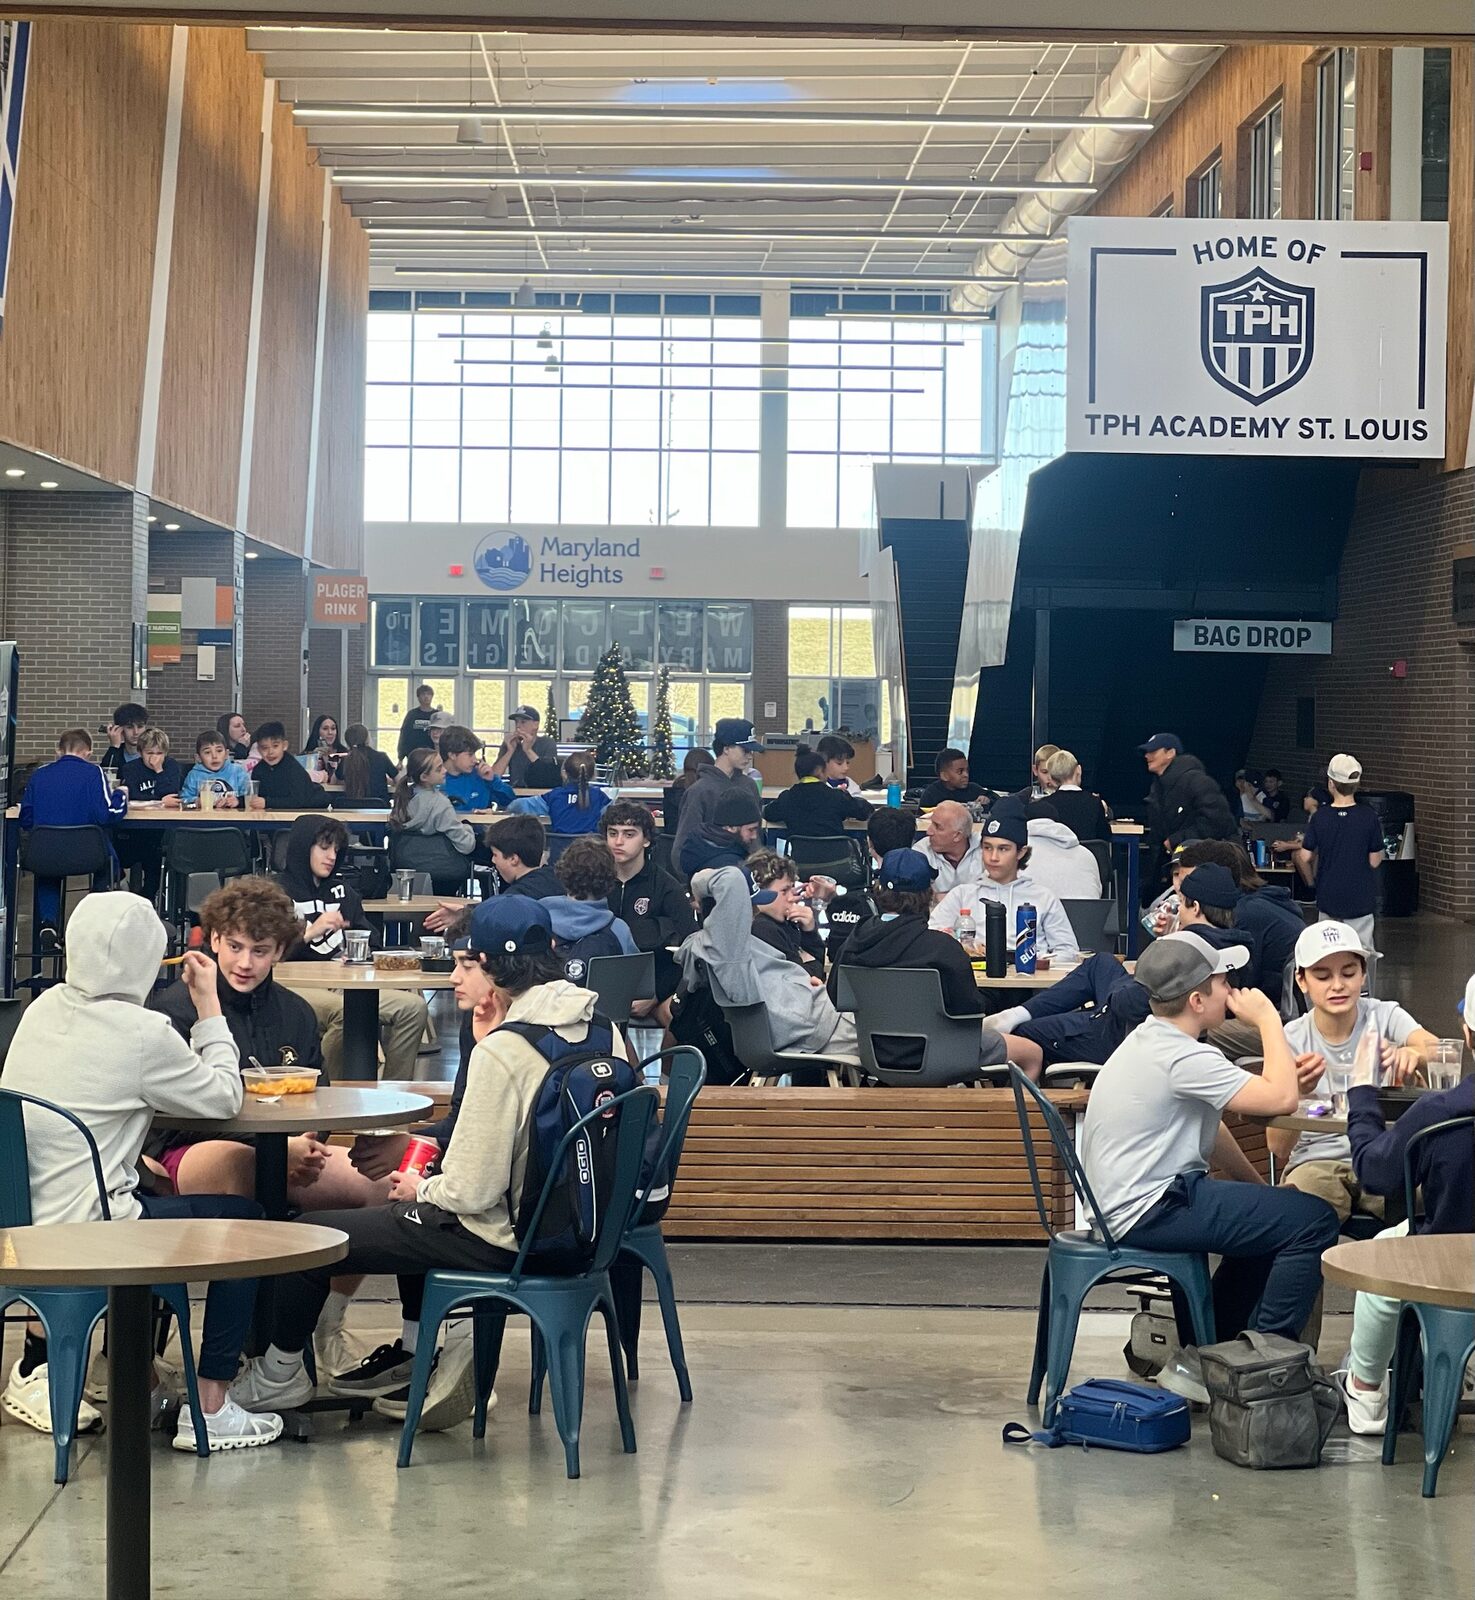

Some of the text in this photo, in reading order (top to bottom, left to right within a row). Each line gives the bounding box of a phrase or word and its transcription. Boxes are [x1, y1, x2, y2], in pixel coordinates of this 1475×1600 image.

[1193, 236, 1327, 264] HOME OF
[1217, 304, 1298, 336] TPH
[1085, 414, 1429, 441] TPH ACADEMY ST. LOUIS
[541, 536, 641, 561] Maryland
[540, 563, 624, 588] Heights
[317, 583, 365, 598] PLAGER
[325, 603, 357, 616] RINK
[1194, 625, 1312, 648] BAG DROP
[330, 884, 345, 899] 17
[576, 1139, 590, 1184] OGIO
